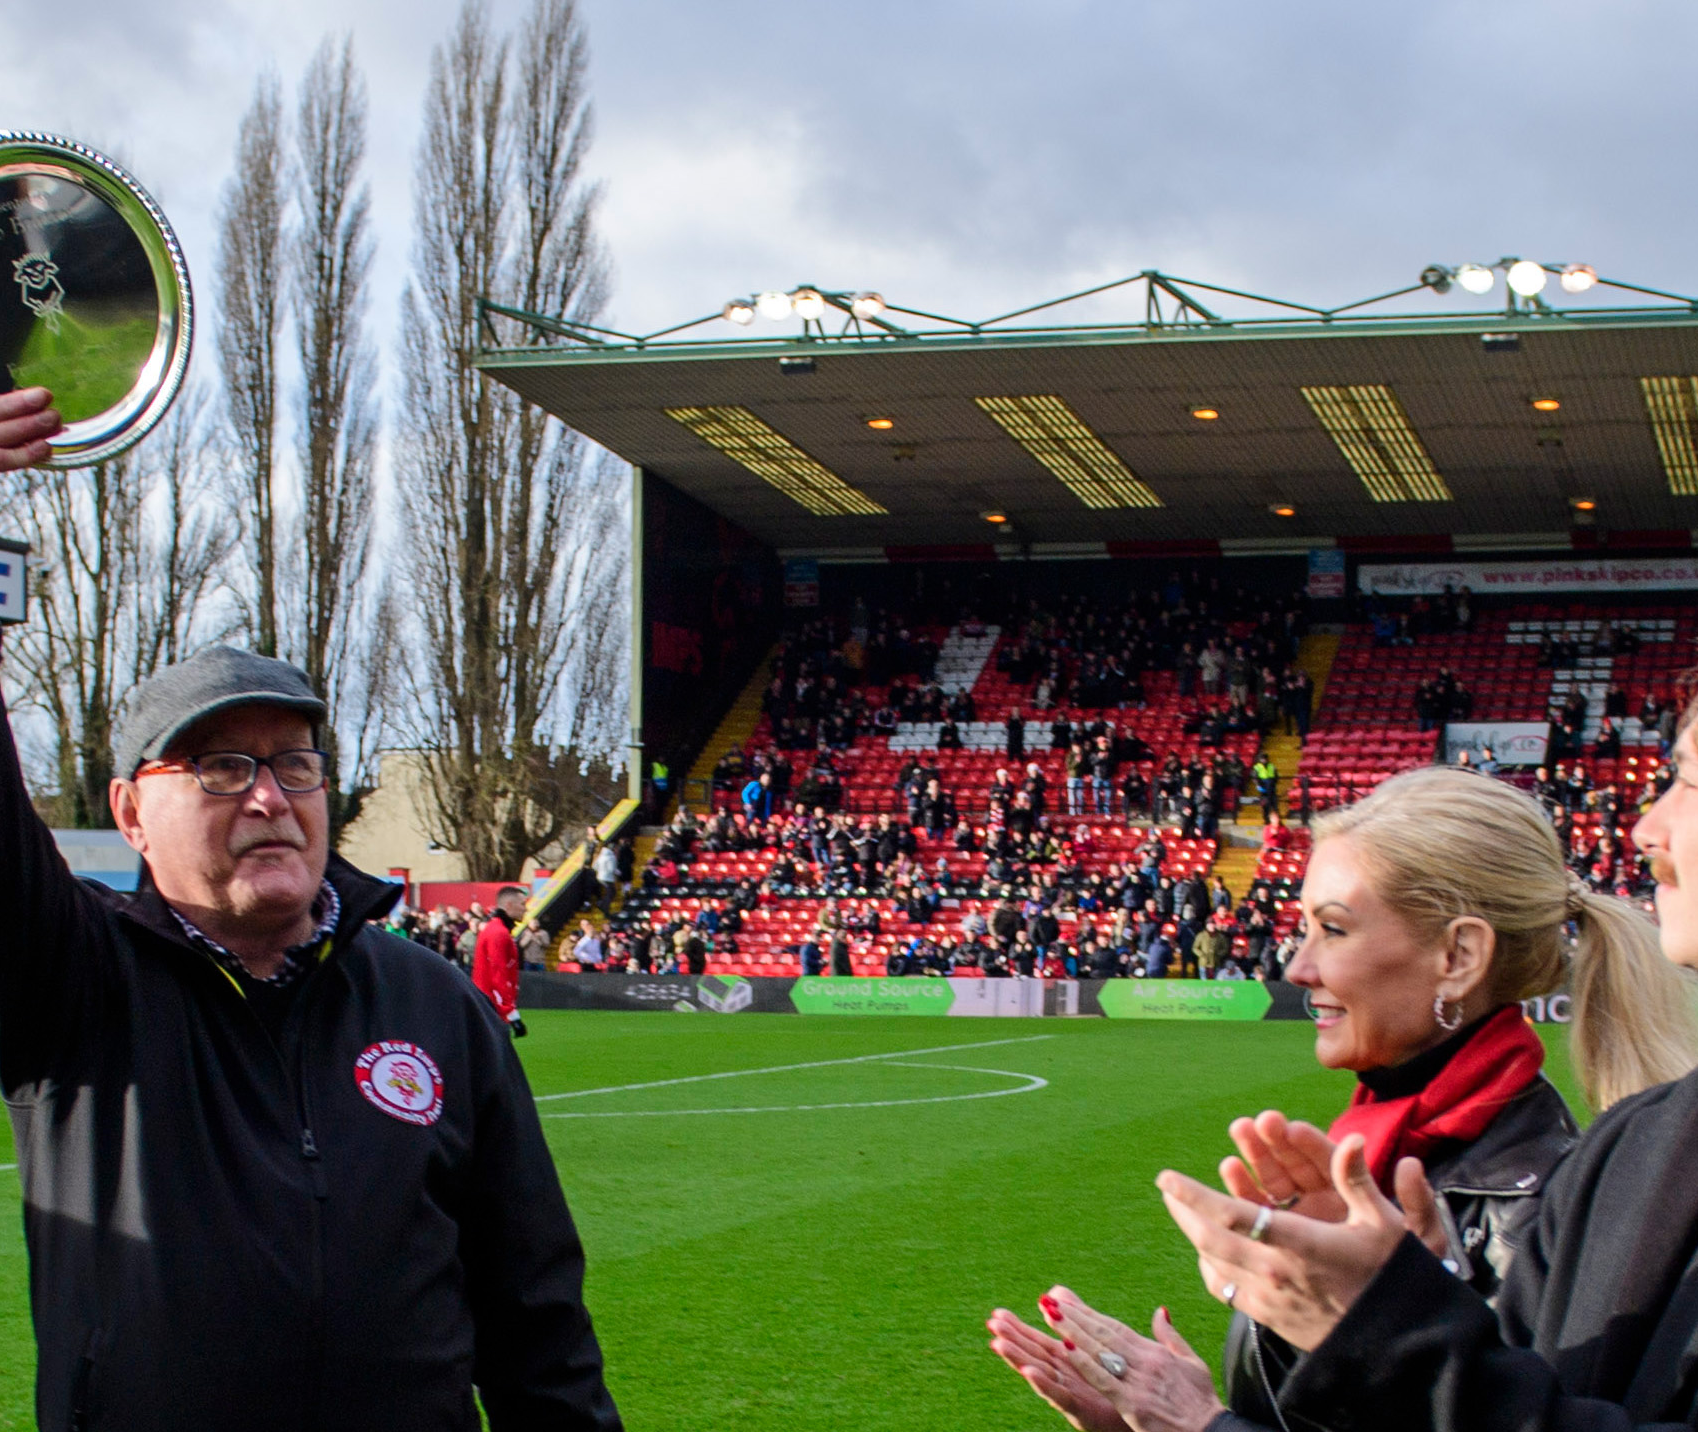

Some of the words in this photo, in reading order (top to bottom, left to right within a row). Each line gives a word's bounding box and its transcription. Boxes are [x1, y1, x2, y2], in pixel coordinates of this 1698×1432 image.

[803, 980, 872, 997] Ground
[878, 980, 944, 998] Source
[1132, 981, 1159, 998] Air
[1167, 981, 1235, 999] Source
[833, 1001, 863, 1011] Heat
[867, 1001, 909, 1012] Pumps
[1142, 1003, 1174, 1014] Heat
[1178, 1003, 1223, 1015] Pumps
[356, 1048, 382, 1069] The
[378, 1041, 412, 1053] Red
